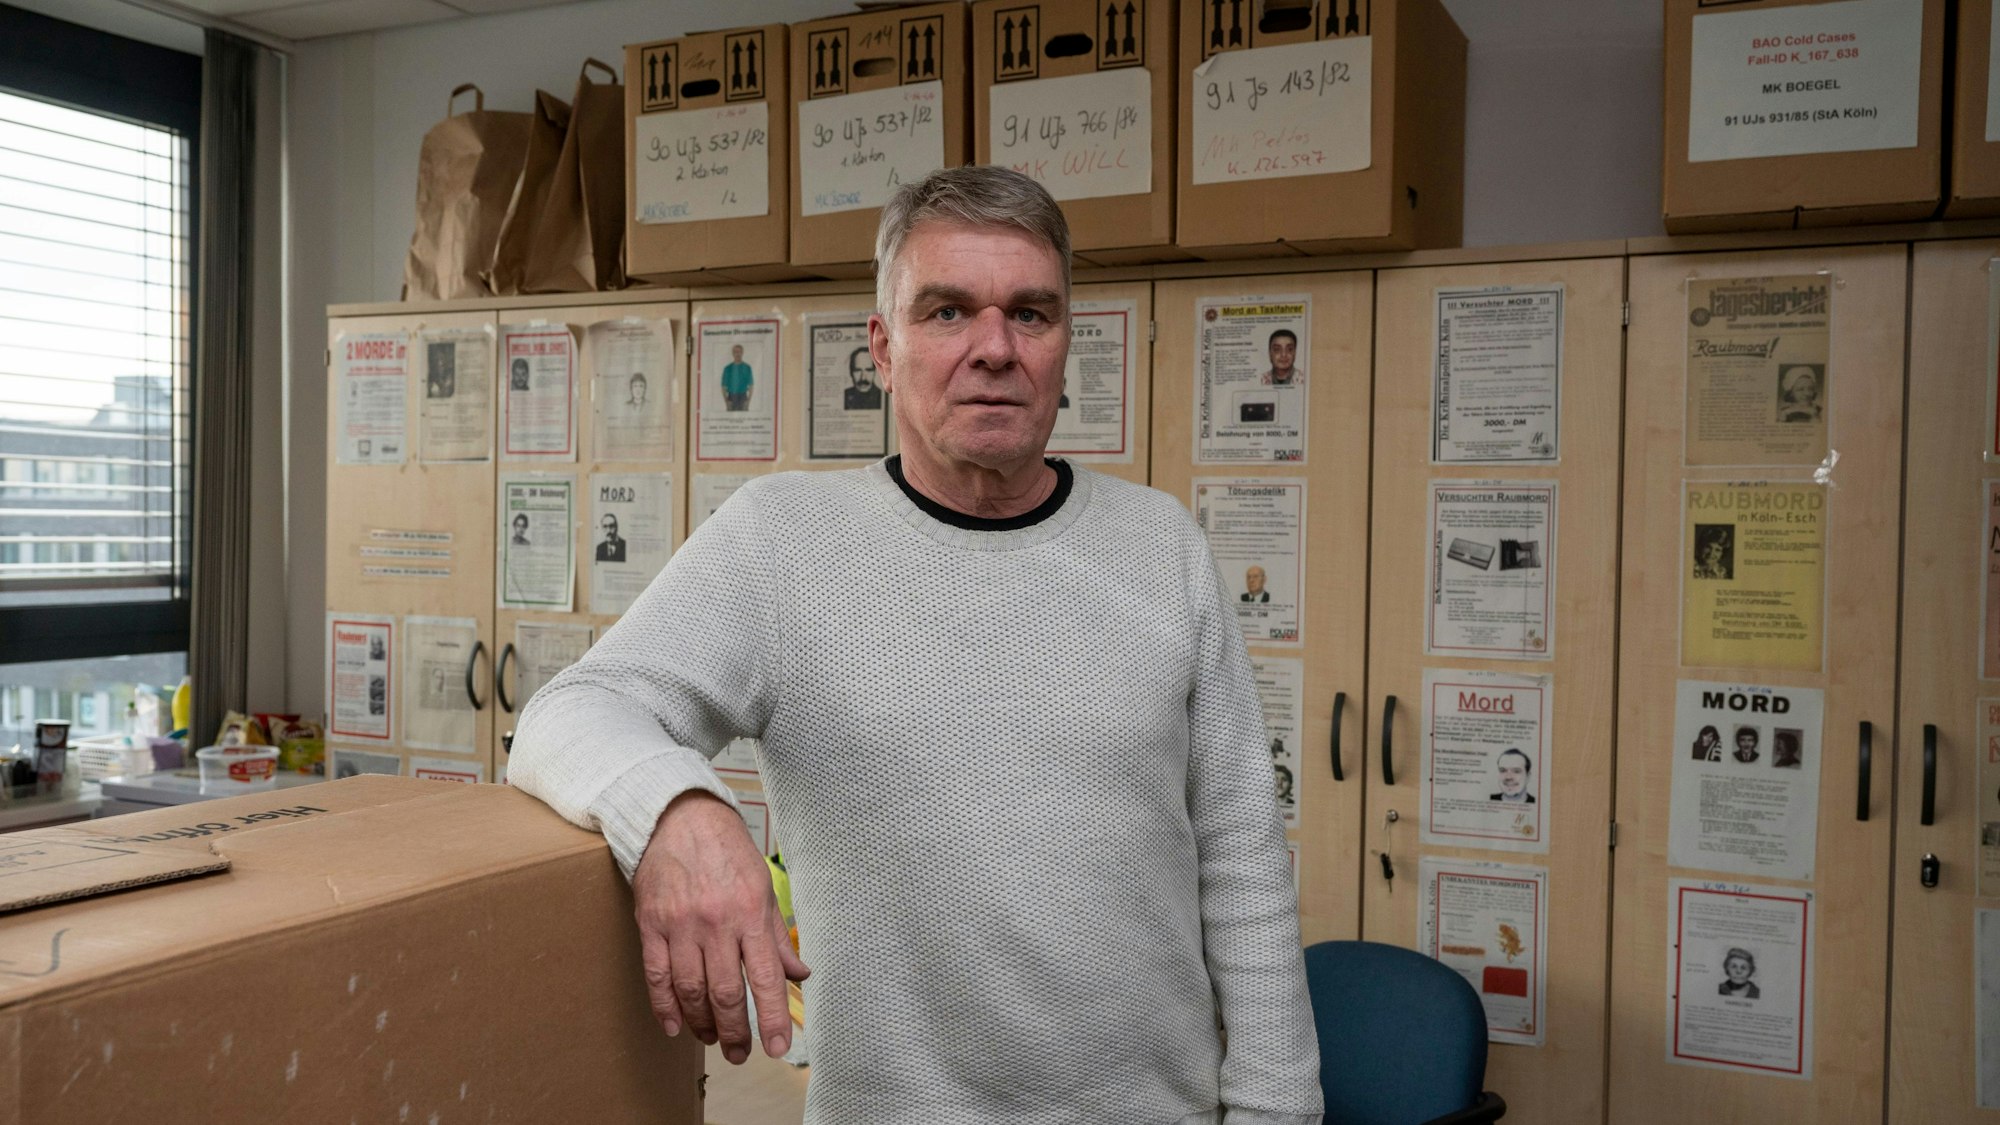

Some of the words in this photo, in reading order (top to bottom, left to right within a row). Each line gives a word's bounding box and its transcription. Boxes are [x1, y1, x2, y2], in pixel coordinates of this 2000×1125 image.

[1752, 36, 1781, 49] BAO
[1784, 34, 1814, 46] Cold
[1817, 31, 1857, 44] Cases
[1747, 52, 1788, 66] Fall-ID
[1790, 47, 1860, 64] K_167_638
[1762, 82, 1782, 95] MK
[1785, 79, 1842, 93] BOEGEL
[1724, 115, 1739, 127] 91
[1742, 113, 1766, 126] UJs
[1768, 110, 1810, 124] 931/85
[1811, 108, 1840, 123] (StA
[1843, 106, 1879, 120] Köln)
[1222, 306, 1245, 315] Mord
[1246, 307, 1258, 315] an
[1259, 304, 1304, 315] Taxifahrer
[1507, 297, 1534, 305] MORD
[346, 341, 354, 361] 2
[354, 340, 394, 360] MORDE
[600, 486, 636, 501] MORD
[1687, 490, 1824, 511] RAUBMORD
[1737, 512, 1748, 522] in
[1457, 690, 1515, 712] Mord
[1702, 691, 1791, 714] MORD
[233, 805, 329, 825] Hier
